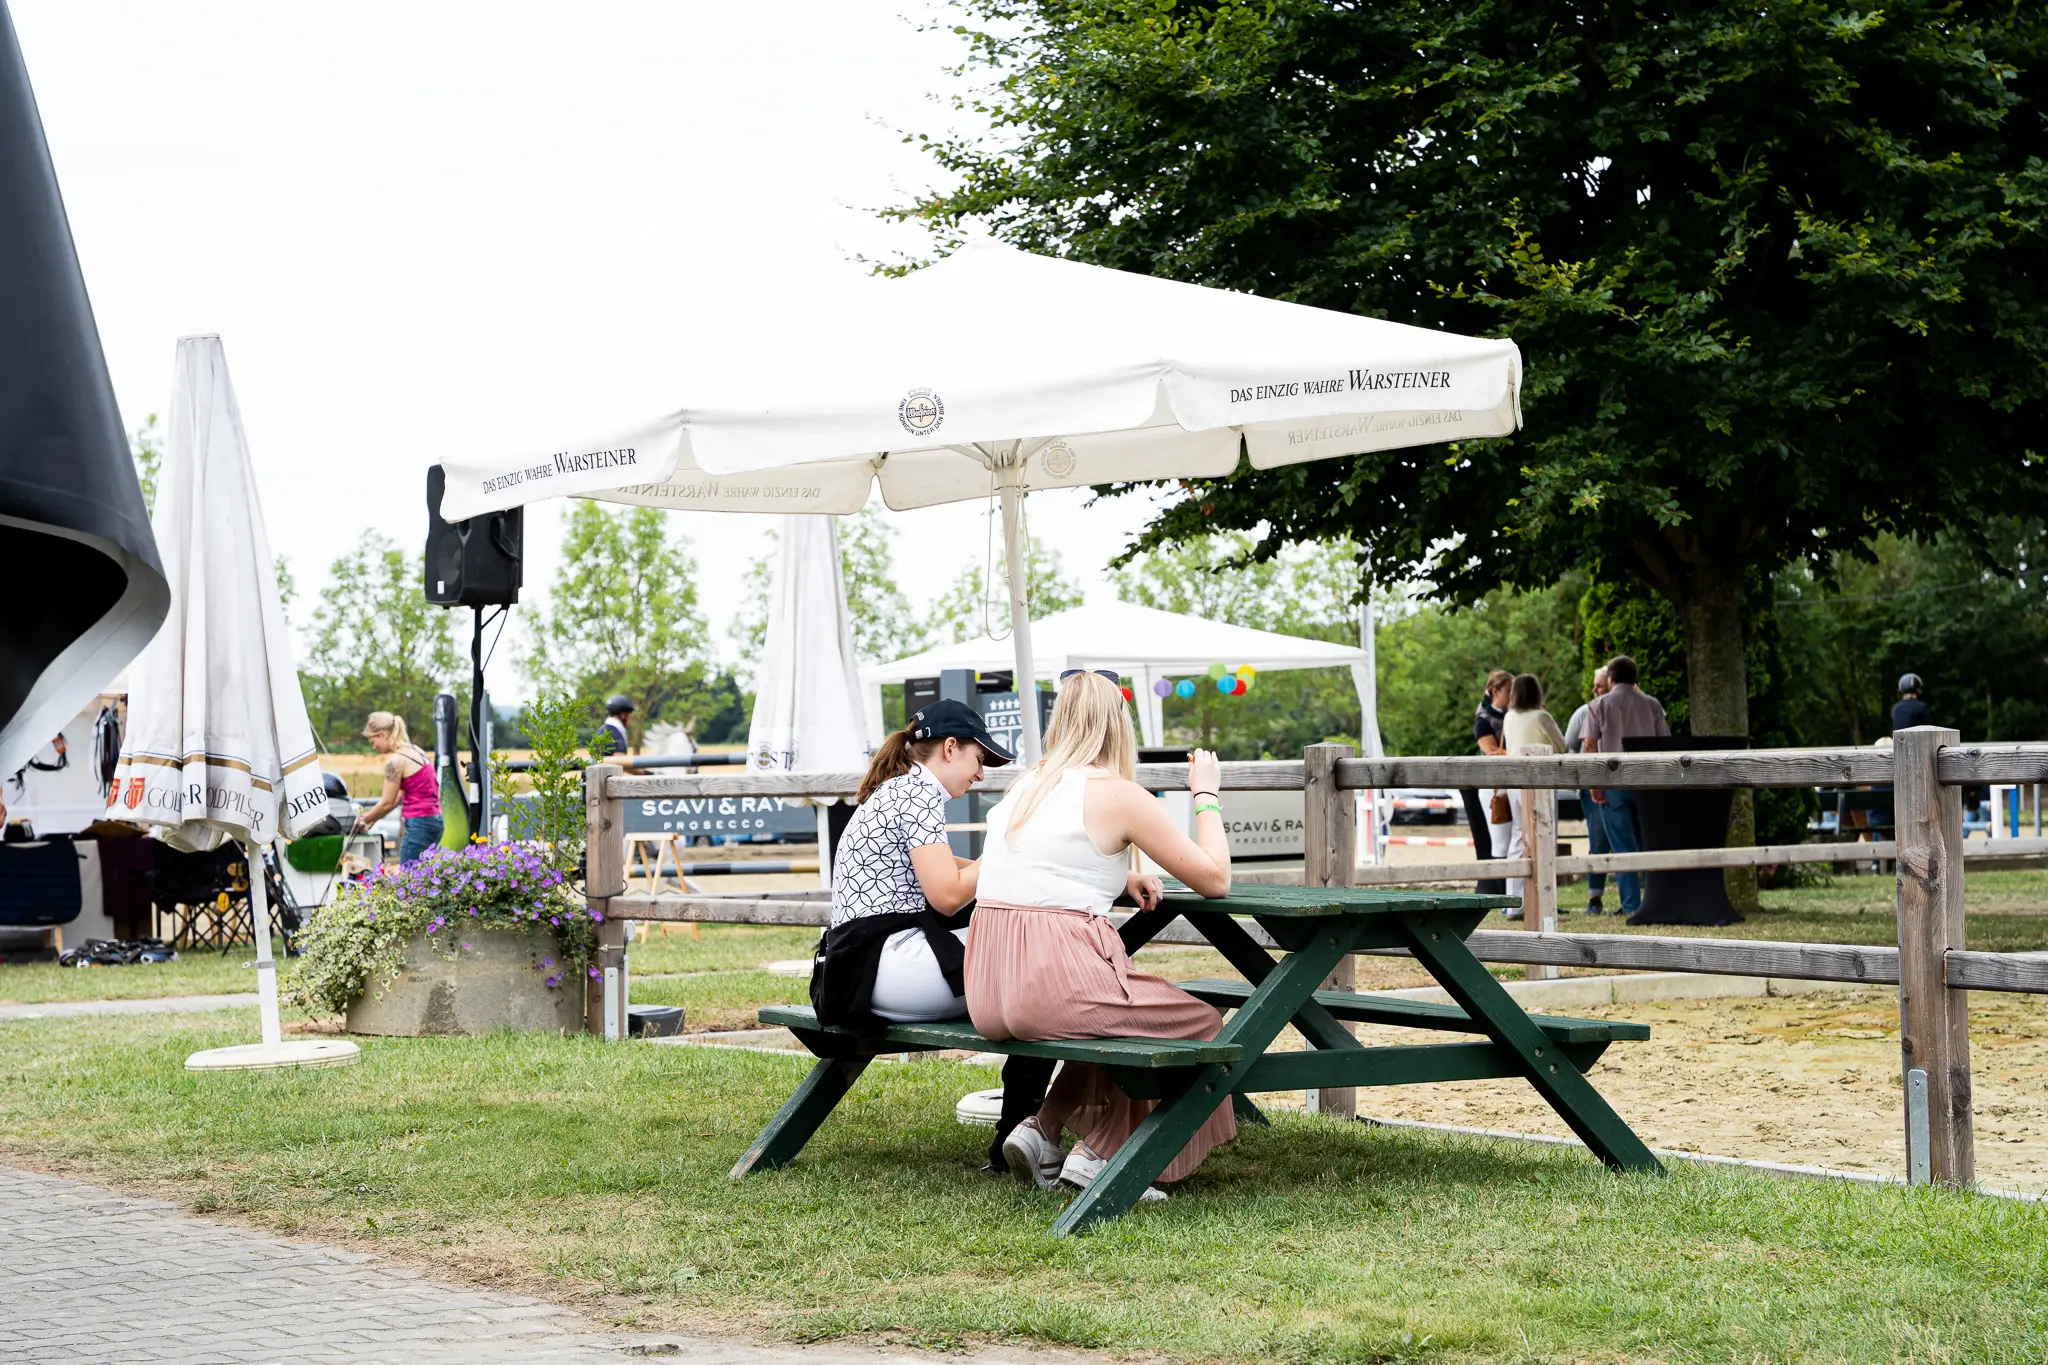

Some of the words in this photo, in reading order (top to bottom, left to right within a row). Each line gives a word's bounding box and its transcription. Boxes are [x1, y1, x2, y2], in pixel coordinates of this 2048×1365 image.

[1230, 387, 1253, 403] DAS
[1256, 382, 1299, 400] EINZIG
[1303, 379, 1345, 395] WAHRE
[1348, 369, 1451, 391] WARSTEINER
[482, 478, 497, 494] DAS
[496, 470, 523, 490] EINZIG
[524, 463, 553, 481] WAHRE
[553, 448, 637, 475] WARSTEINER
[989, 715, 1022, 728] SCAV
[641, 798, 714, 817] SCAVI
[741, 796, 785, 813] RAY
[663, 818, 766, 832] PROSECCO
[1223, 821, 1268, 834] SCAVI
[1285, 819, 1304, 830] RA
[1235, 835, 1299, 845] PROSECCO
